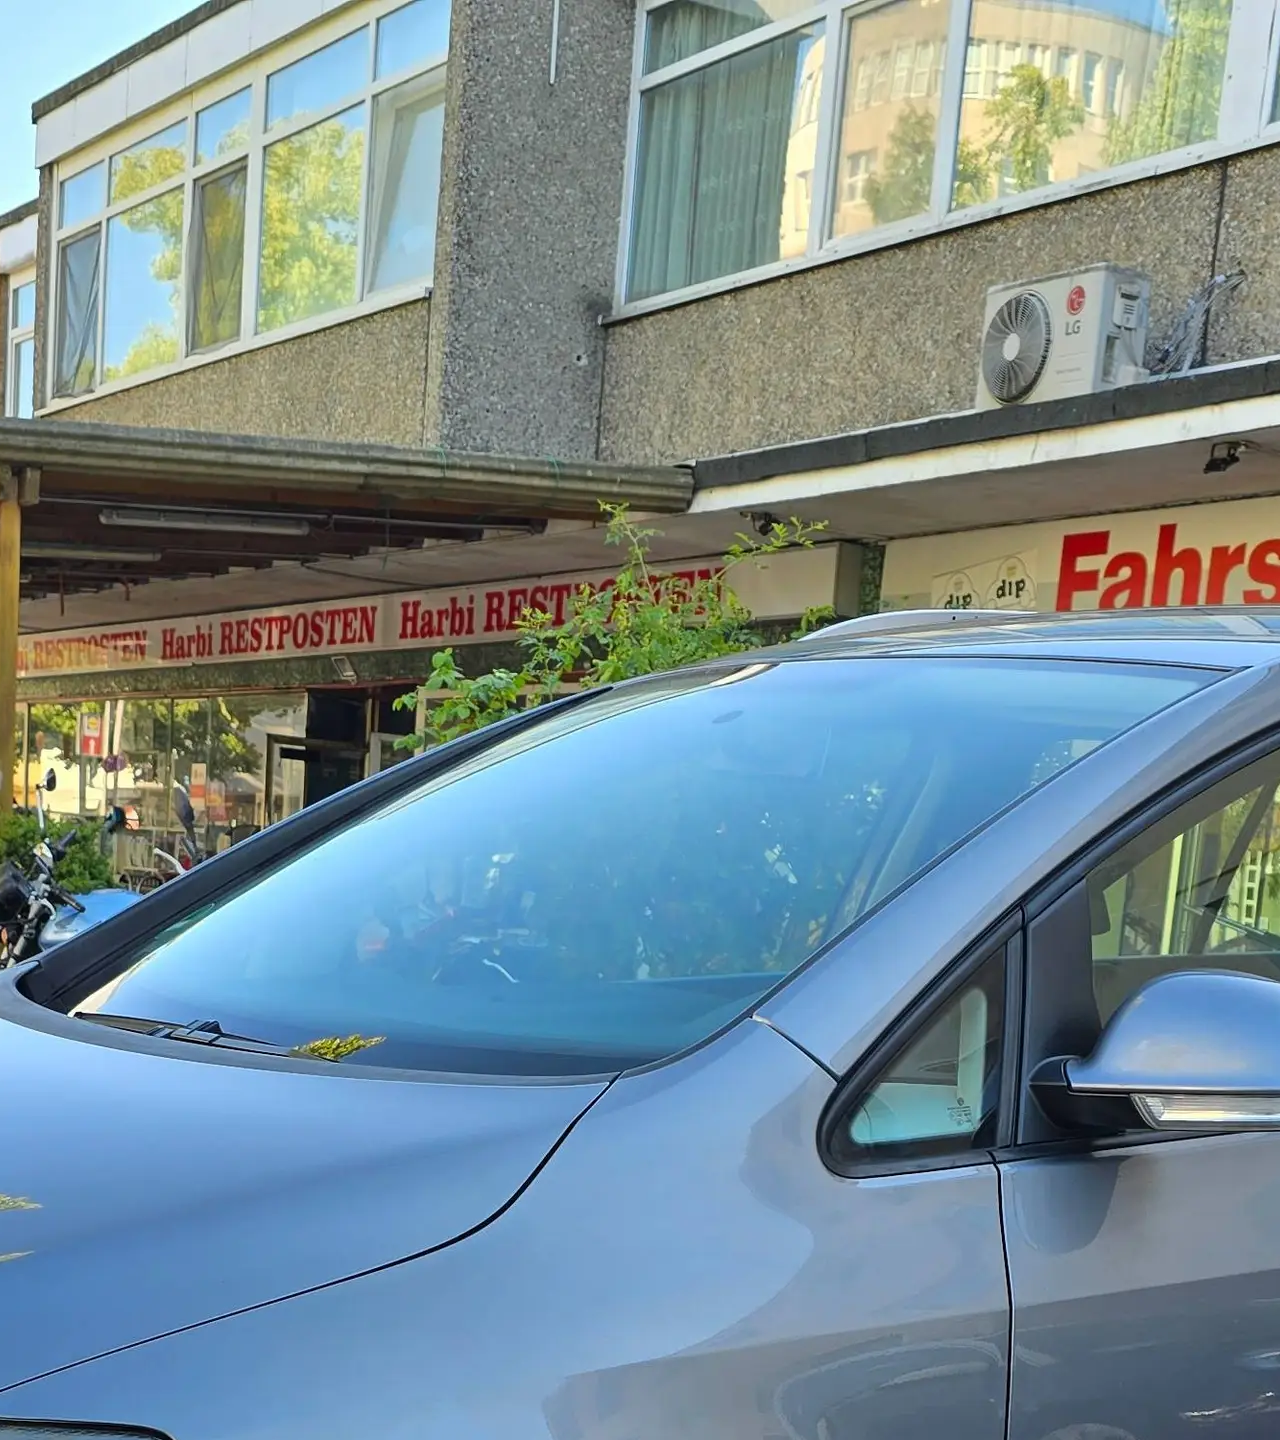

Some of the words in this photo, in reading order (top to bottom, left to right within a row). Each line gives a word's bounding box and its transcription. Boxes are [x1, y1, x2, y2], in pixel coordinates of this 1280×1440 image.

[1064, 320, 1081, 336] LG
[161, 622, 214, 661] Harbi
[220, 606, 377, 655] RESTPOSTEN
[398, 593, 475, 640] Harbi
